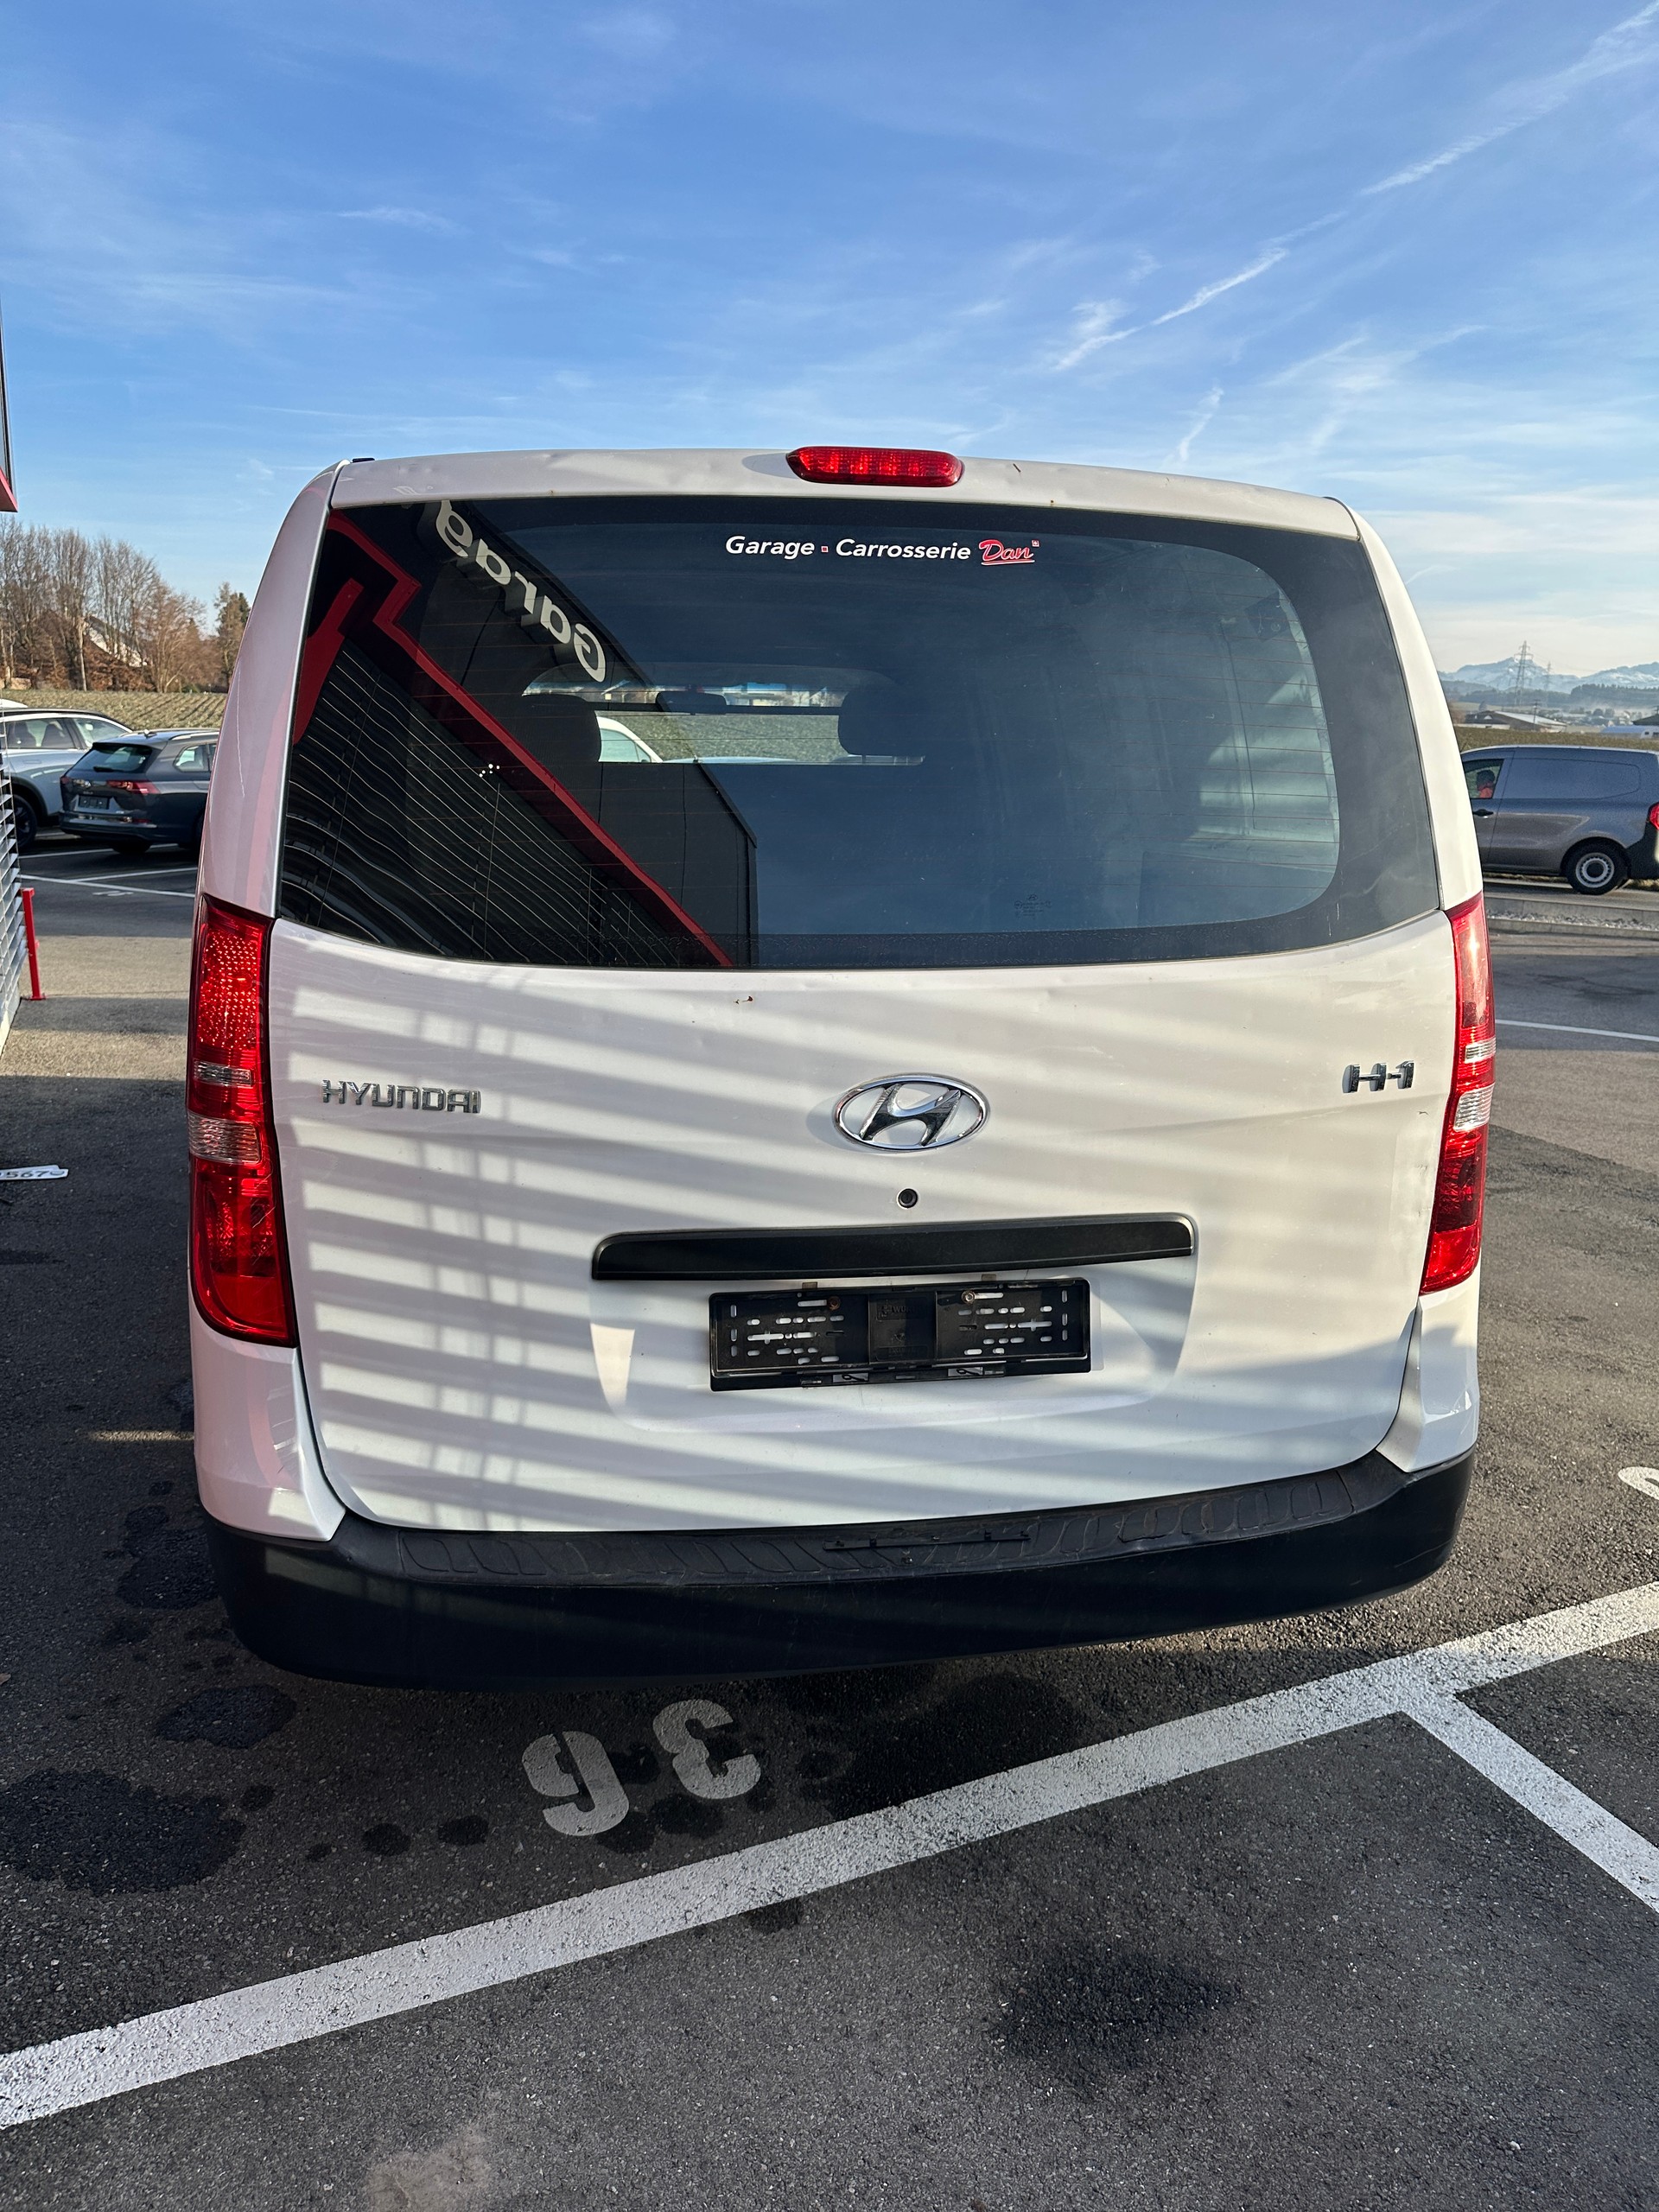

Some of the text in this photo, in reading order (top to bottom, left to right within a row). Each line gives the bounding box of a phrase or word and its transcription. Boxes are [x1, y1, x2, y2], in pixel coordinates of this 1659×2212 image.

[725, 535, 1037, 565] Garage Carrosserie Dan
[1341, 1060, 1414, 1093] H-1
[322, 1079, 481, 1114] HYUNDAI
